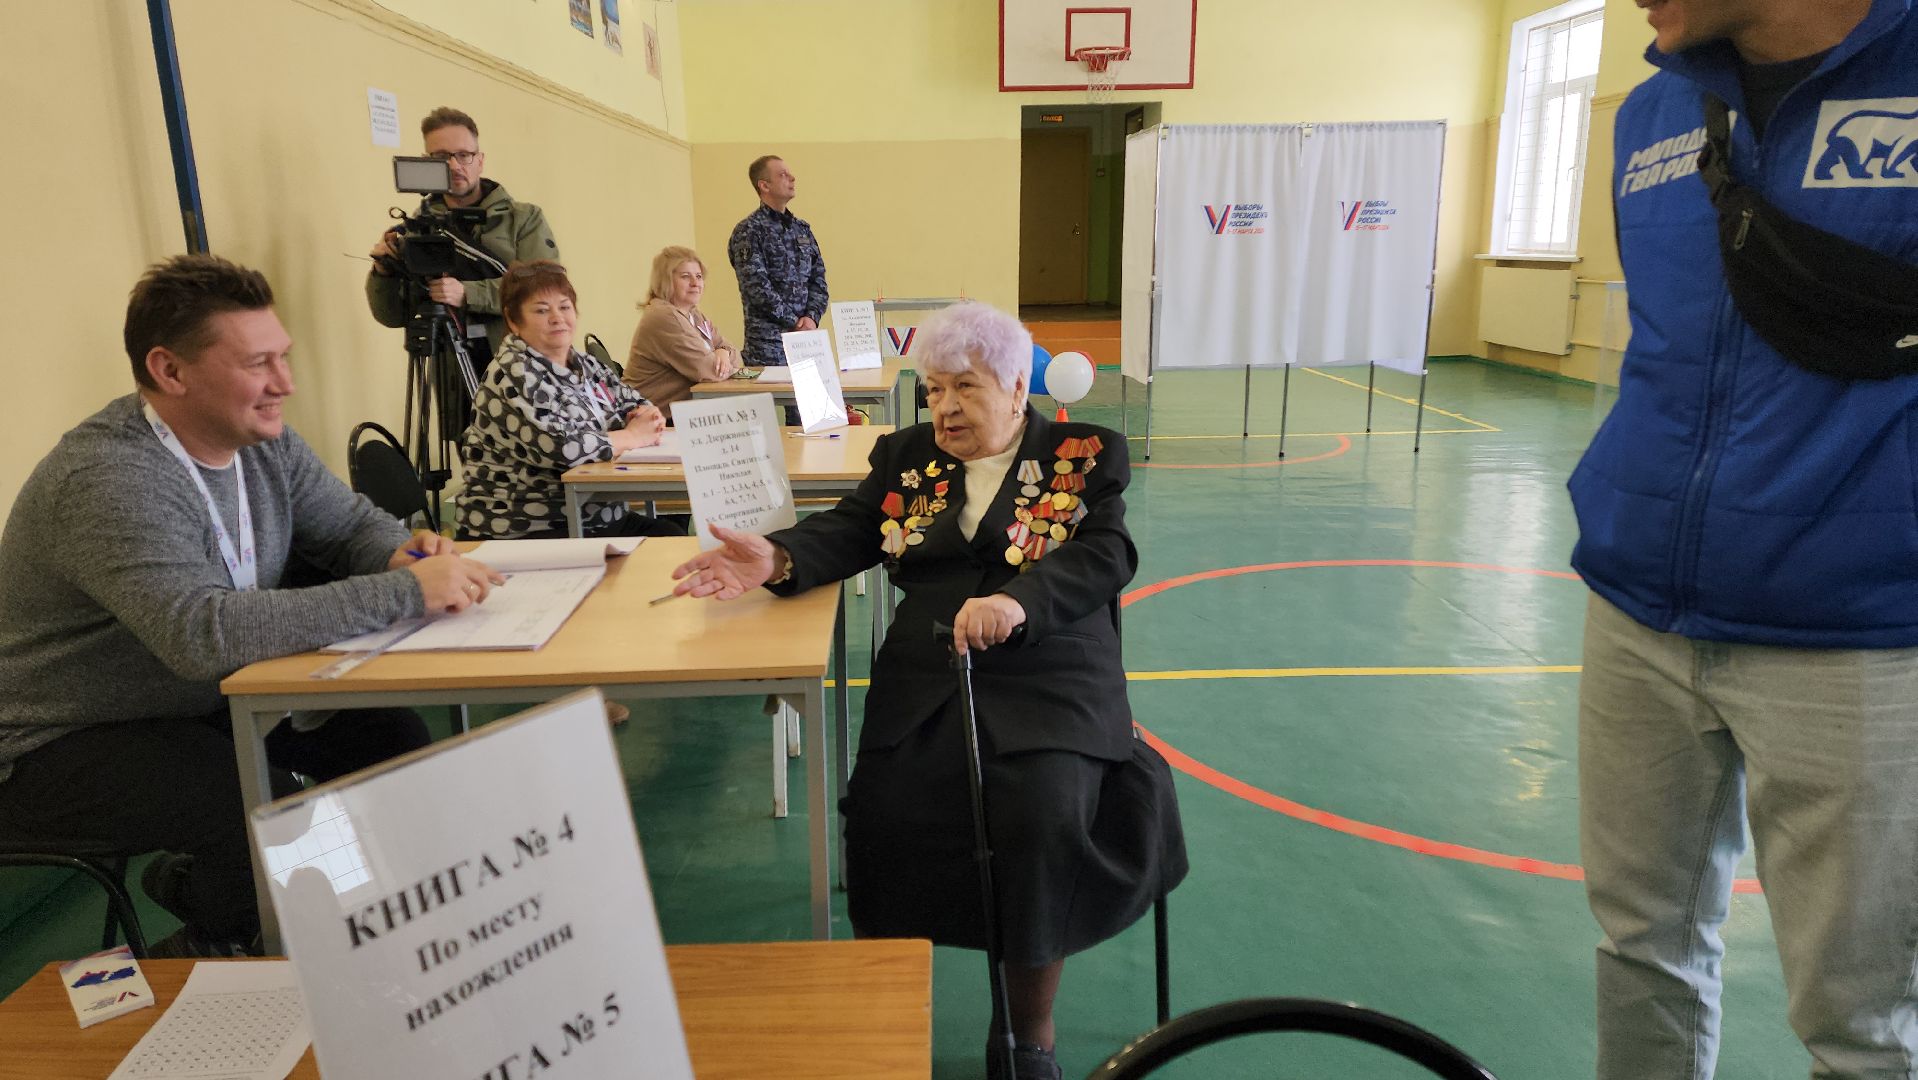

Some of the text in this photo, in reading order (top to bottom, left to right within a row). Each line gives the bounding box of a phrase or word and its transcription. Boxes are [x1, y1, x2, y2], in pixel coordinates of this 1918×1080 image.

[1233, 203, 1264, 211] ВЫБОРЫ
[689, 408, 758, 429] КНИГА № 3
[345, 812, 575, 950] КНИГА № 4
[415, 891, 544, 974] По месту
[403, 921, 574, 1033] нахождения
[561, 1012, 597, 1057] №
[602, 991, 621, 1027] 5
